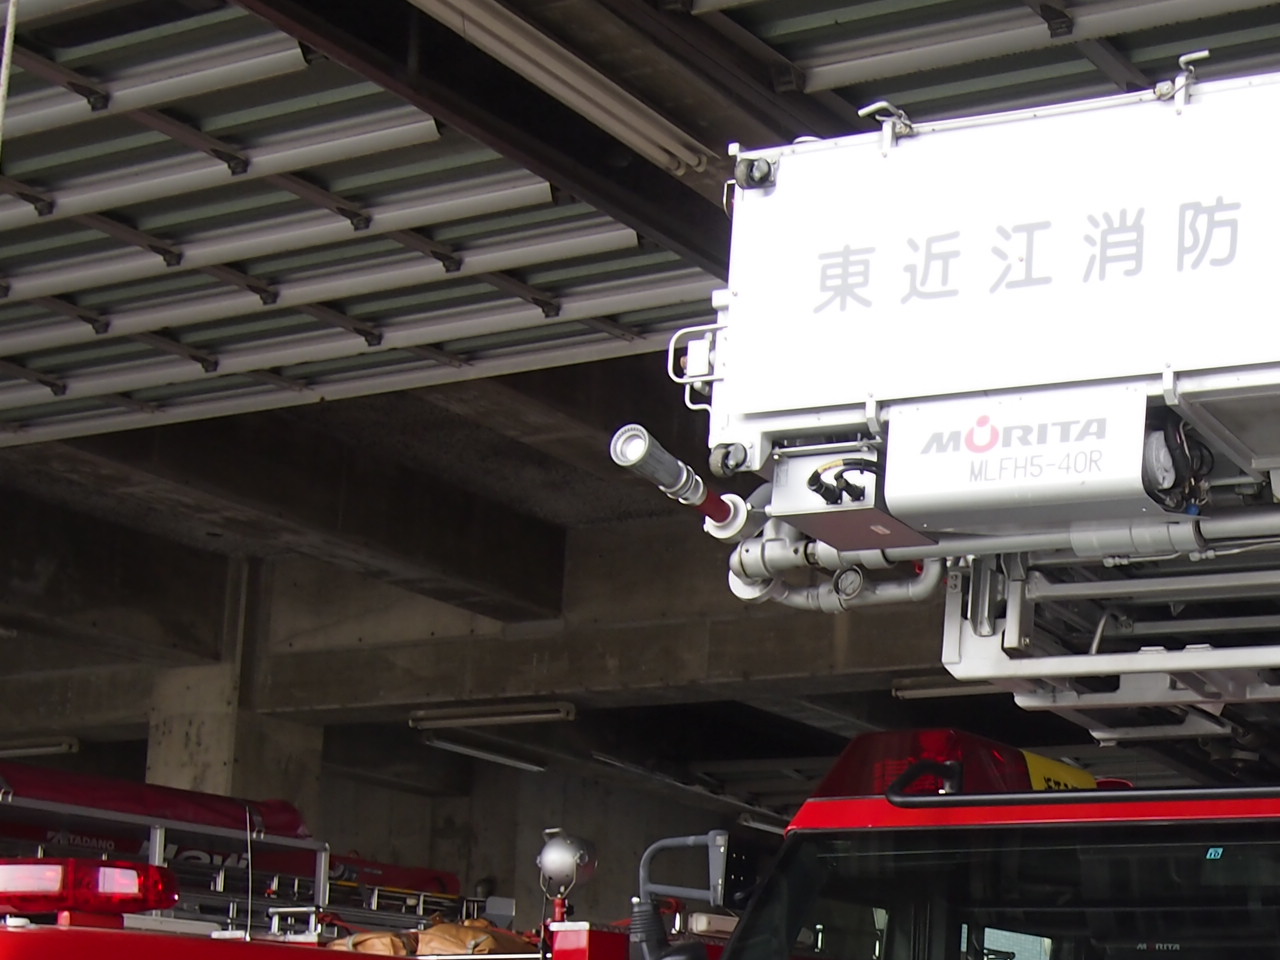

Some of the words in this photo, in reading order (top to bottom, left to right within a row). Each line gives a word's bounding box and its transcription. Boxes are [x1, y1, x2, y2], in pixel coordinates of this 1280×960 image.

[813, 195, 1241, 314] 東近江消防
[920, 415, 1107, 454] MORITA
[969, 450, 1103, 483] MLFH5-40R
[68, 834, 116, 850] TADANO
[1136, 939, 1181, 951] MORITA
